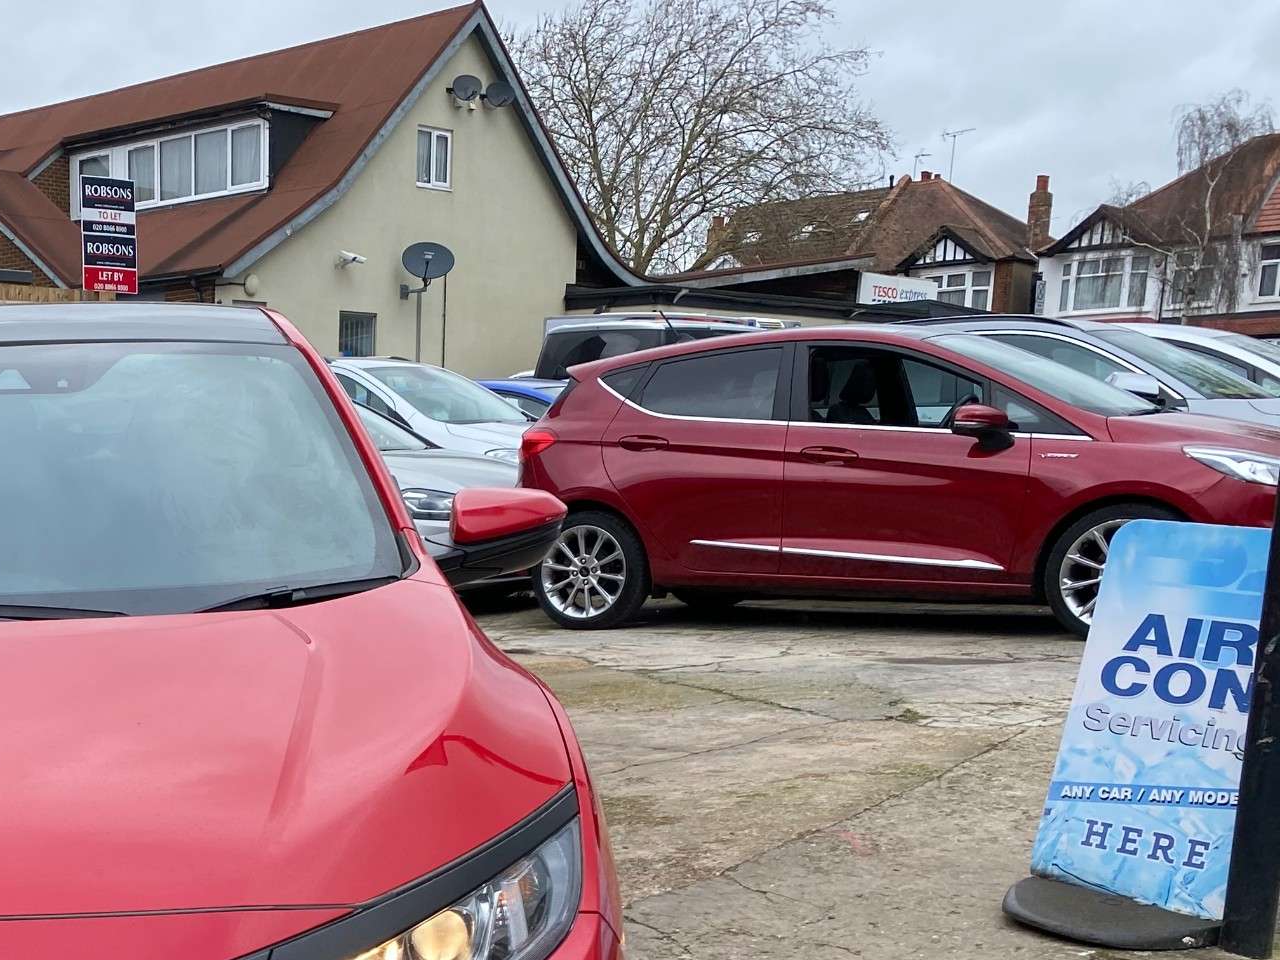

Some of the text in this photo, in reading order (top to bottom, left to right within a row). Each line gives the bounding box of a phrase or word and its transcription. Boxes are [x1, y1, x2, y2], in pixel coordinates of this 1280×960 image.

[85, 184, 132, 200] ROBSONS
[98, 210, 122, 221] TO LET
[87, 242, 134, 257] ROBSONS
[98, 271, 123, 281] LET BY
[873, 285, 898, 299] TESCO
[1122, 613, 1259, 667] AIR
[1100, 655, 1254, 714] CON
[1061, 785, 1094, 799] ANY
[1097, 786, 1133, 801] CAR
[1136, 788, 1145, 802] /
[1148, 788, 1184, 804] ANY
[1080, 818, 1211, 870] HERE
